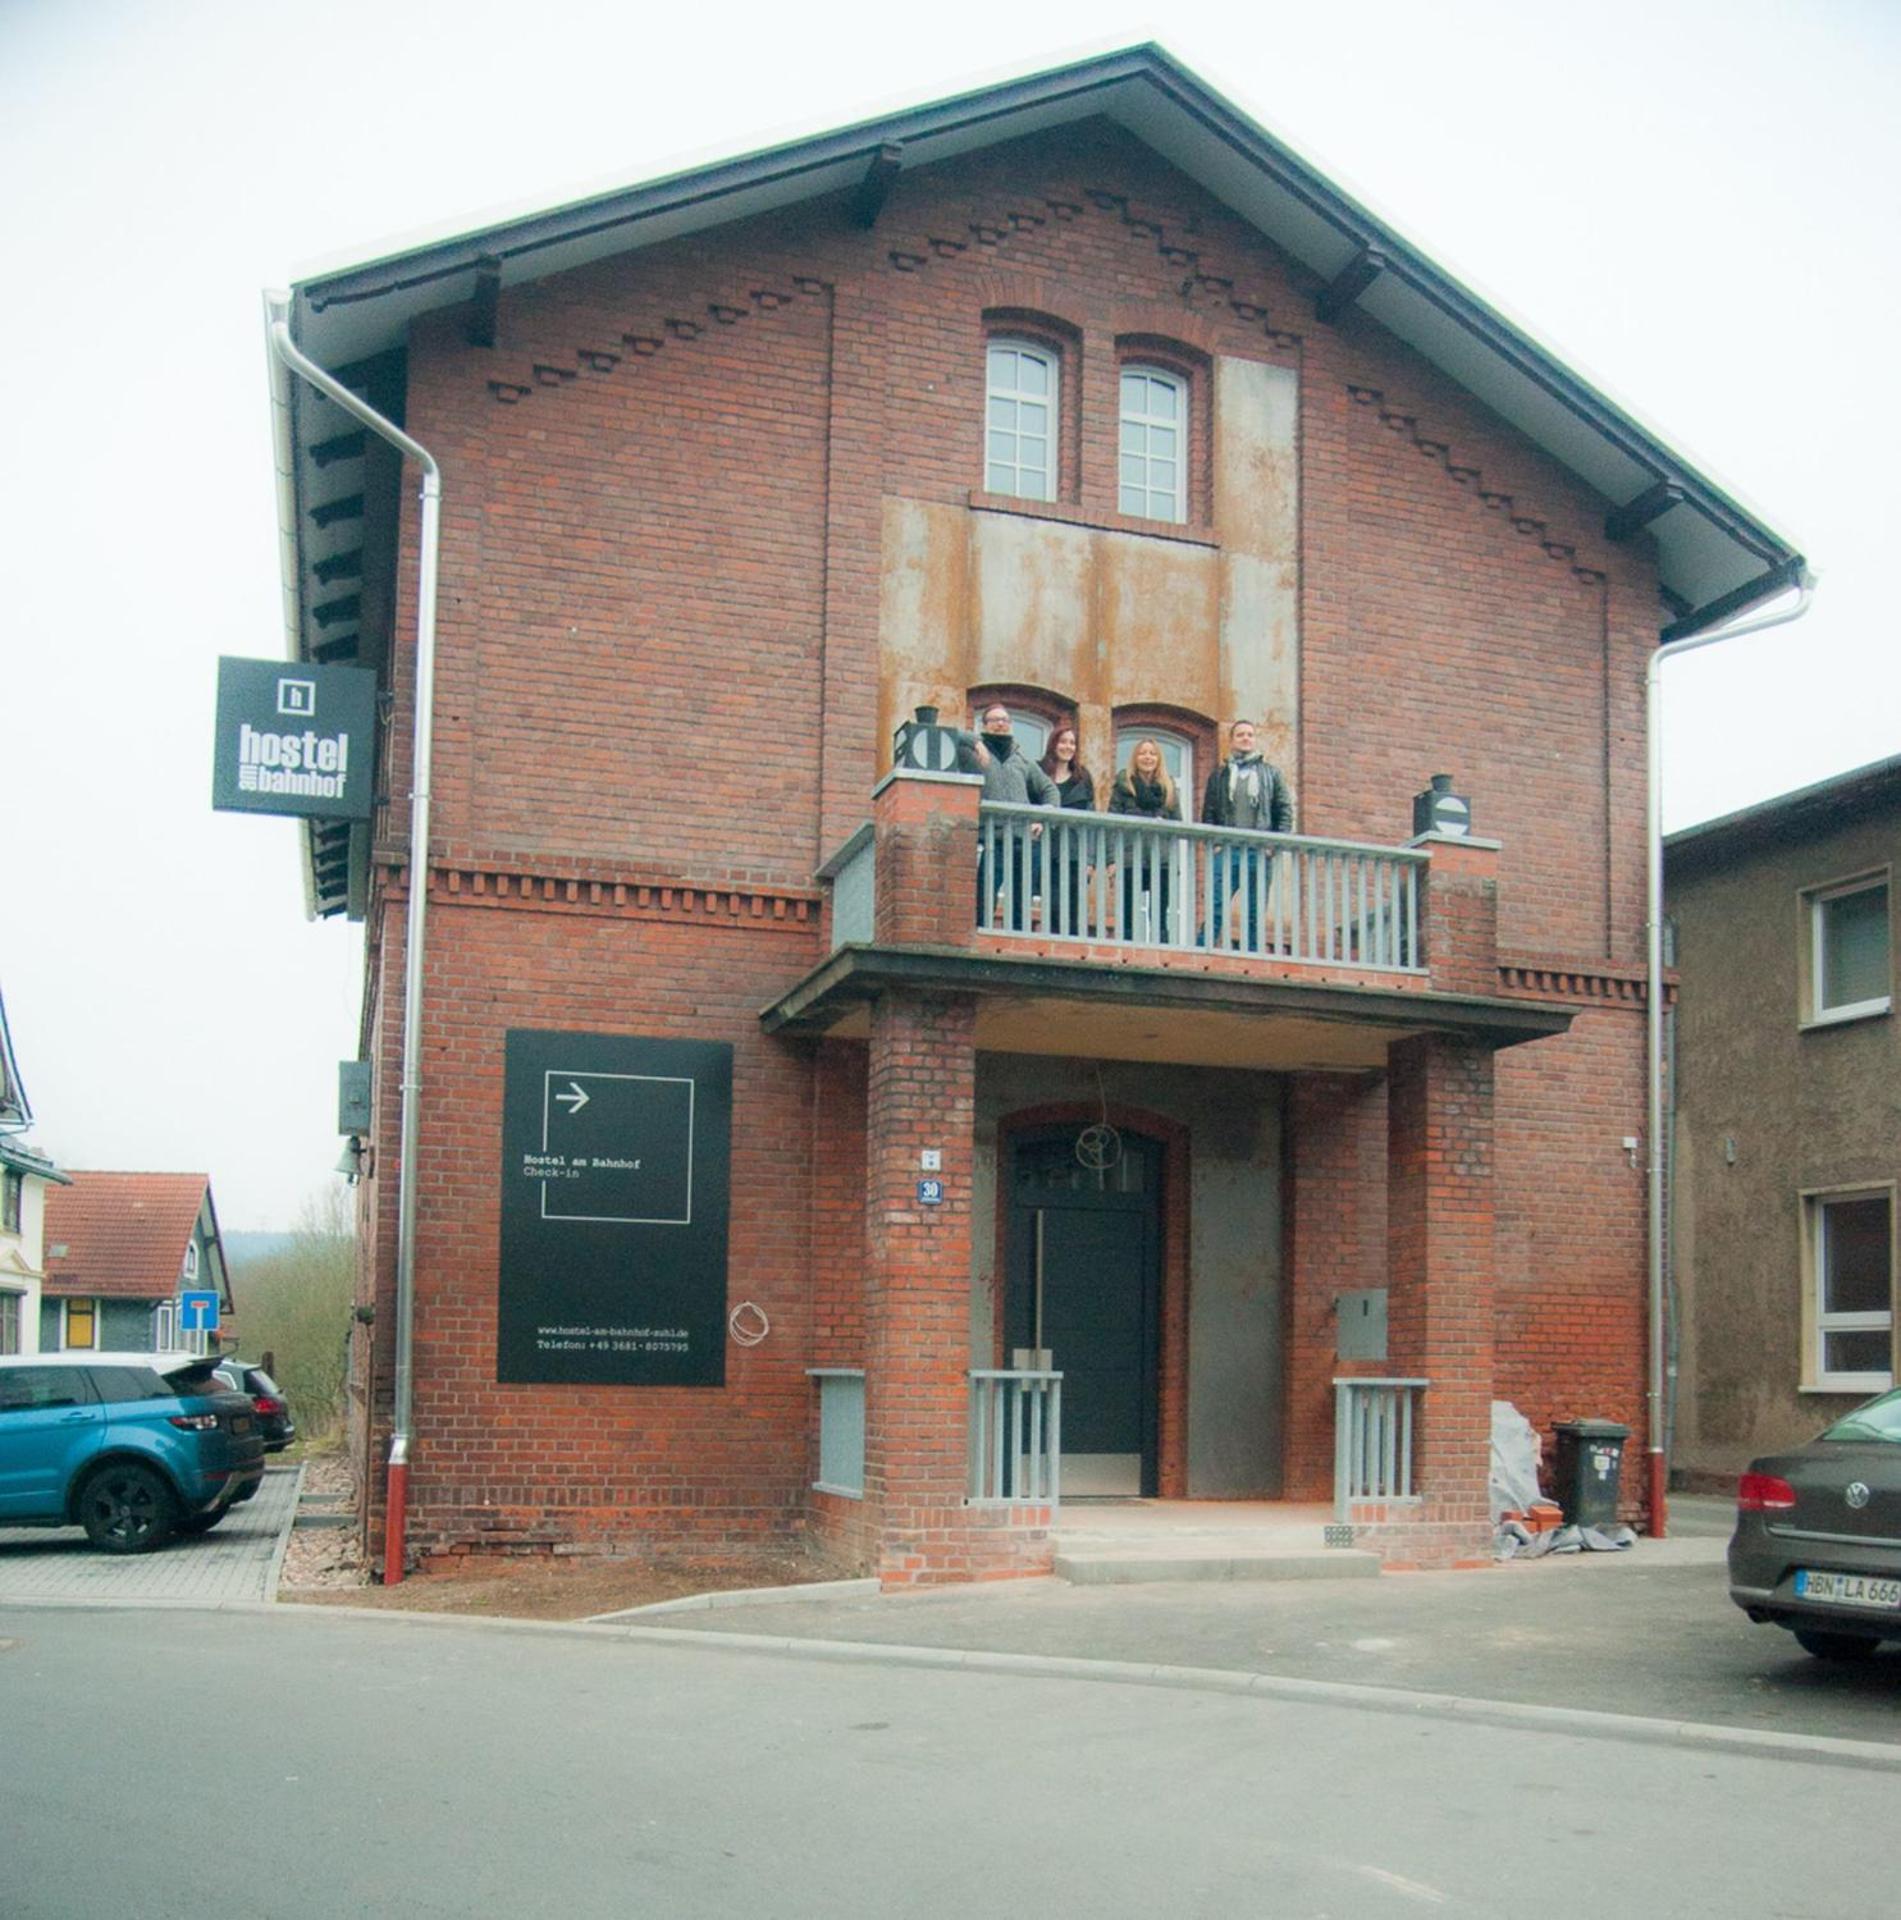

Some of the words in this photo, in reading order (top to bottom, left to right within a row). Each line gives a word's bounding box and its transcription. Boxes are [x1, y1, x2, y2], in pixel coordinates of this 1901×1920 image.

[239, 723, 348, 772] hostel
[258, 766, 347, 799] bahnhof
[523, 1154, 566, 1166] Hostel
[572, 1158, 587, 1167] am
[592, 1157, 641, 1169] Bahnhof
[523, 1166, 580, 1178] Check-in
[923, 1182, 939, 1198] 30
[536, 1340, 586, 1350] Telefon:
[1807, 1575, 1834, 1596] HBN
[1844, 1579, 1865, 1599] LA
[1868, 1581, 1900, 1603] 666
